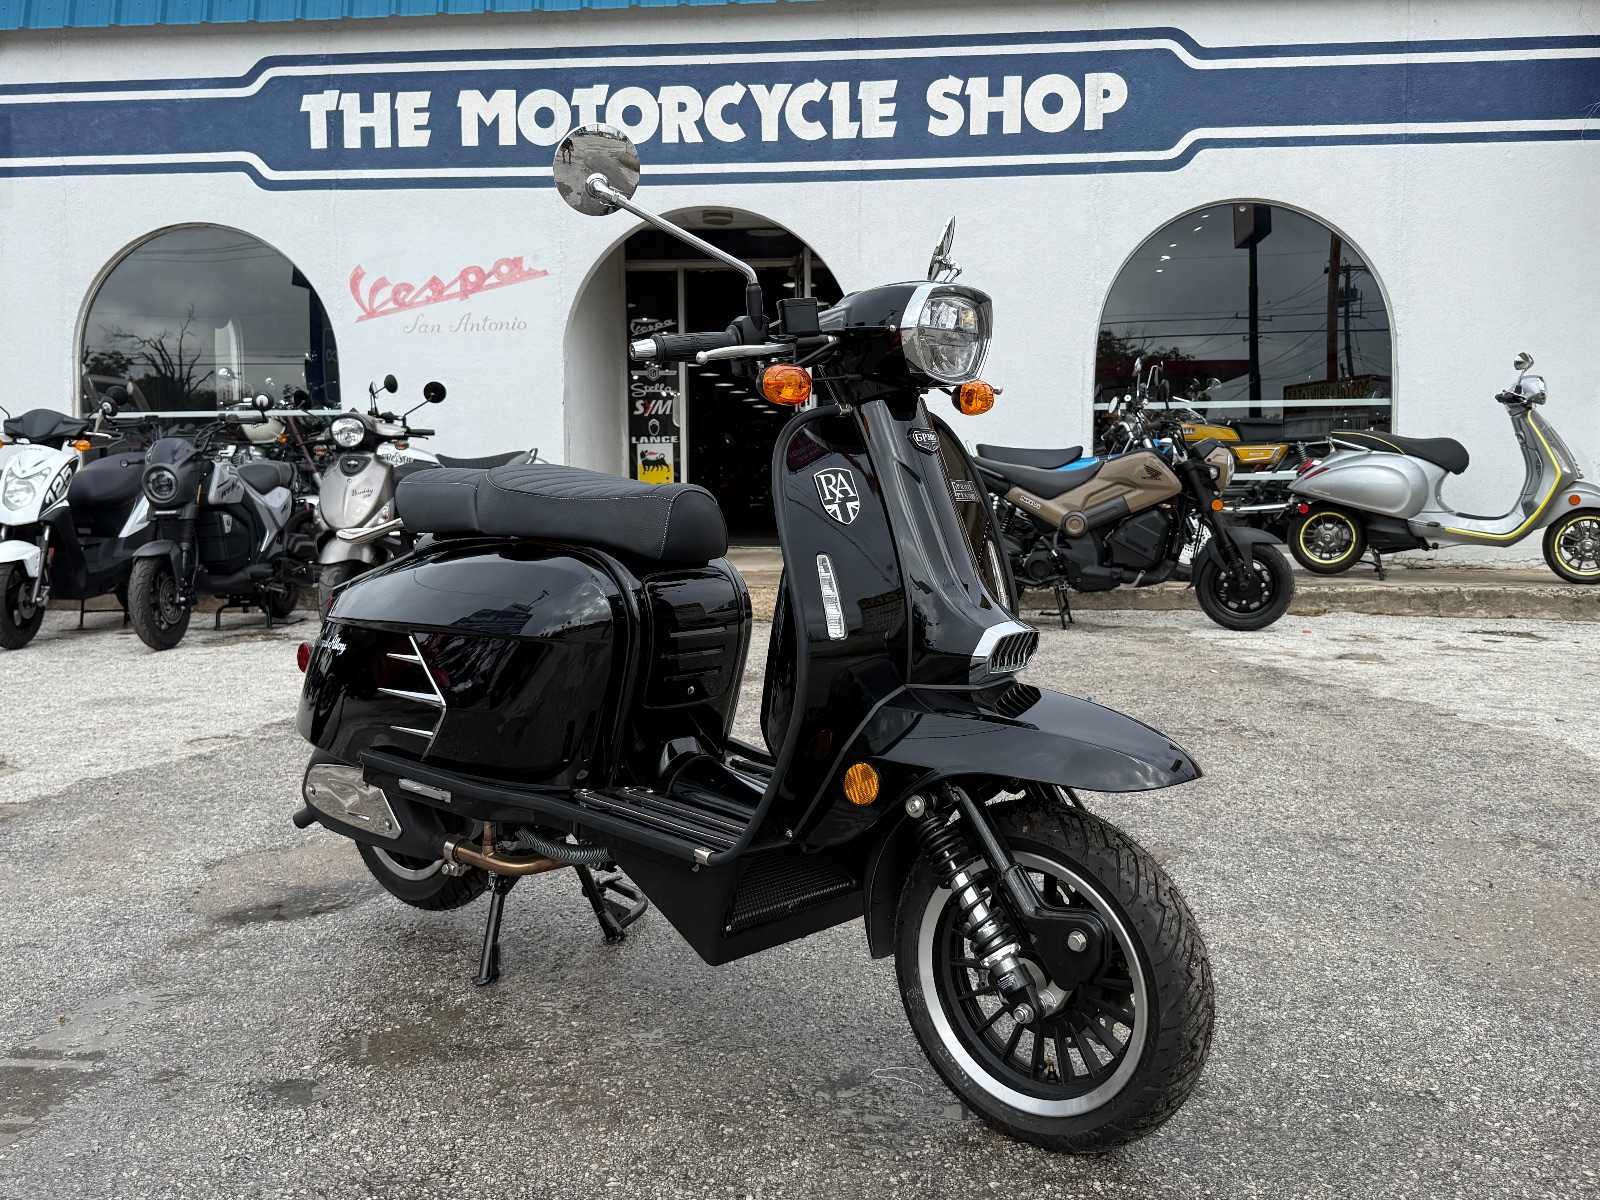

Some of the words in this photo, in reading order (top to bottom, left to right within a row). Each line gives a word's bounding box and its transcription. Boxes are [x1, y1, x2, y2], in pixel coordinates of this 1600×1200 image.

[300, 90, 431, 149] THE
[457, 78, 898, 147] MOTORCYCLE
[926, 72, 1128, 137] SHOP
[349, 256, 549, 323] Vespa
[403, 313, 441, 334] San
[449, 312, 527, 332] Antonio
[630, 319, 677, 337] Vespa
[630, 382, 672, 398] Stella
[633, 399, 672, 416] SYM
[632, 435, 679, 444] LANCE
[45, 464, 72, 504] 125
